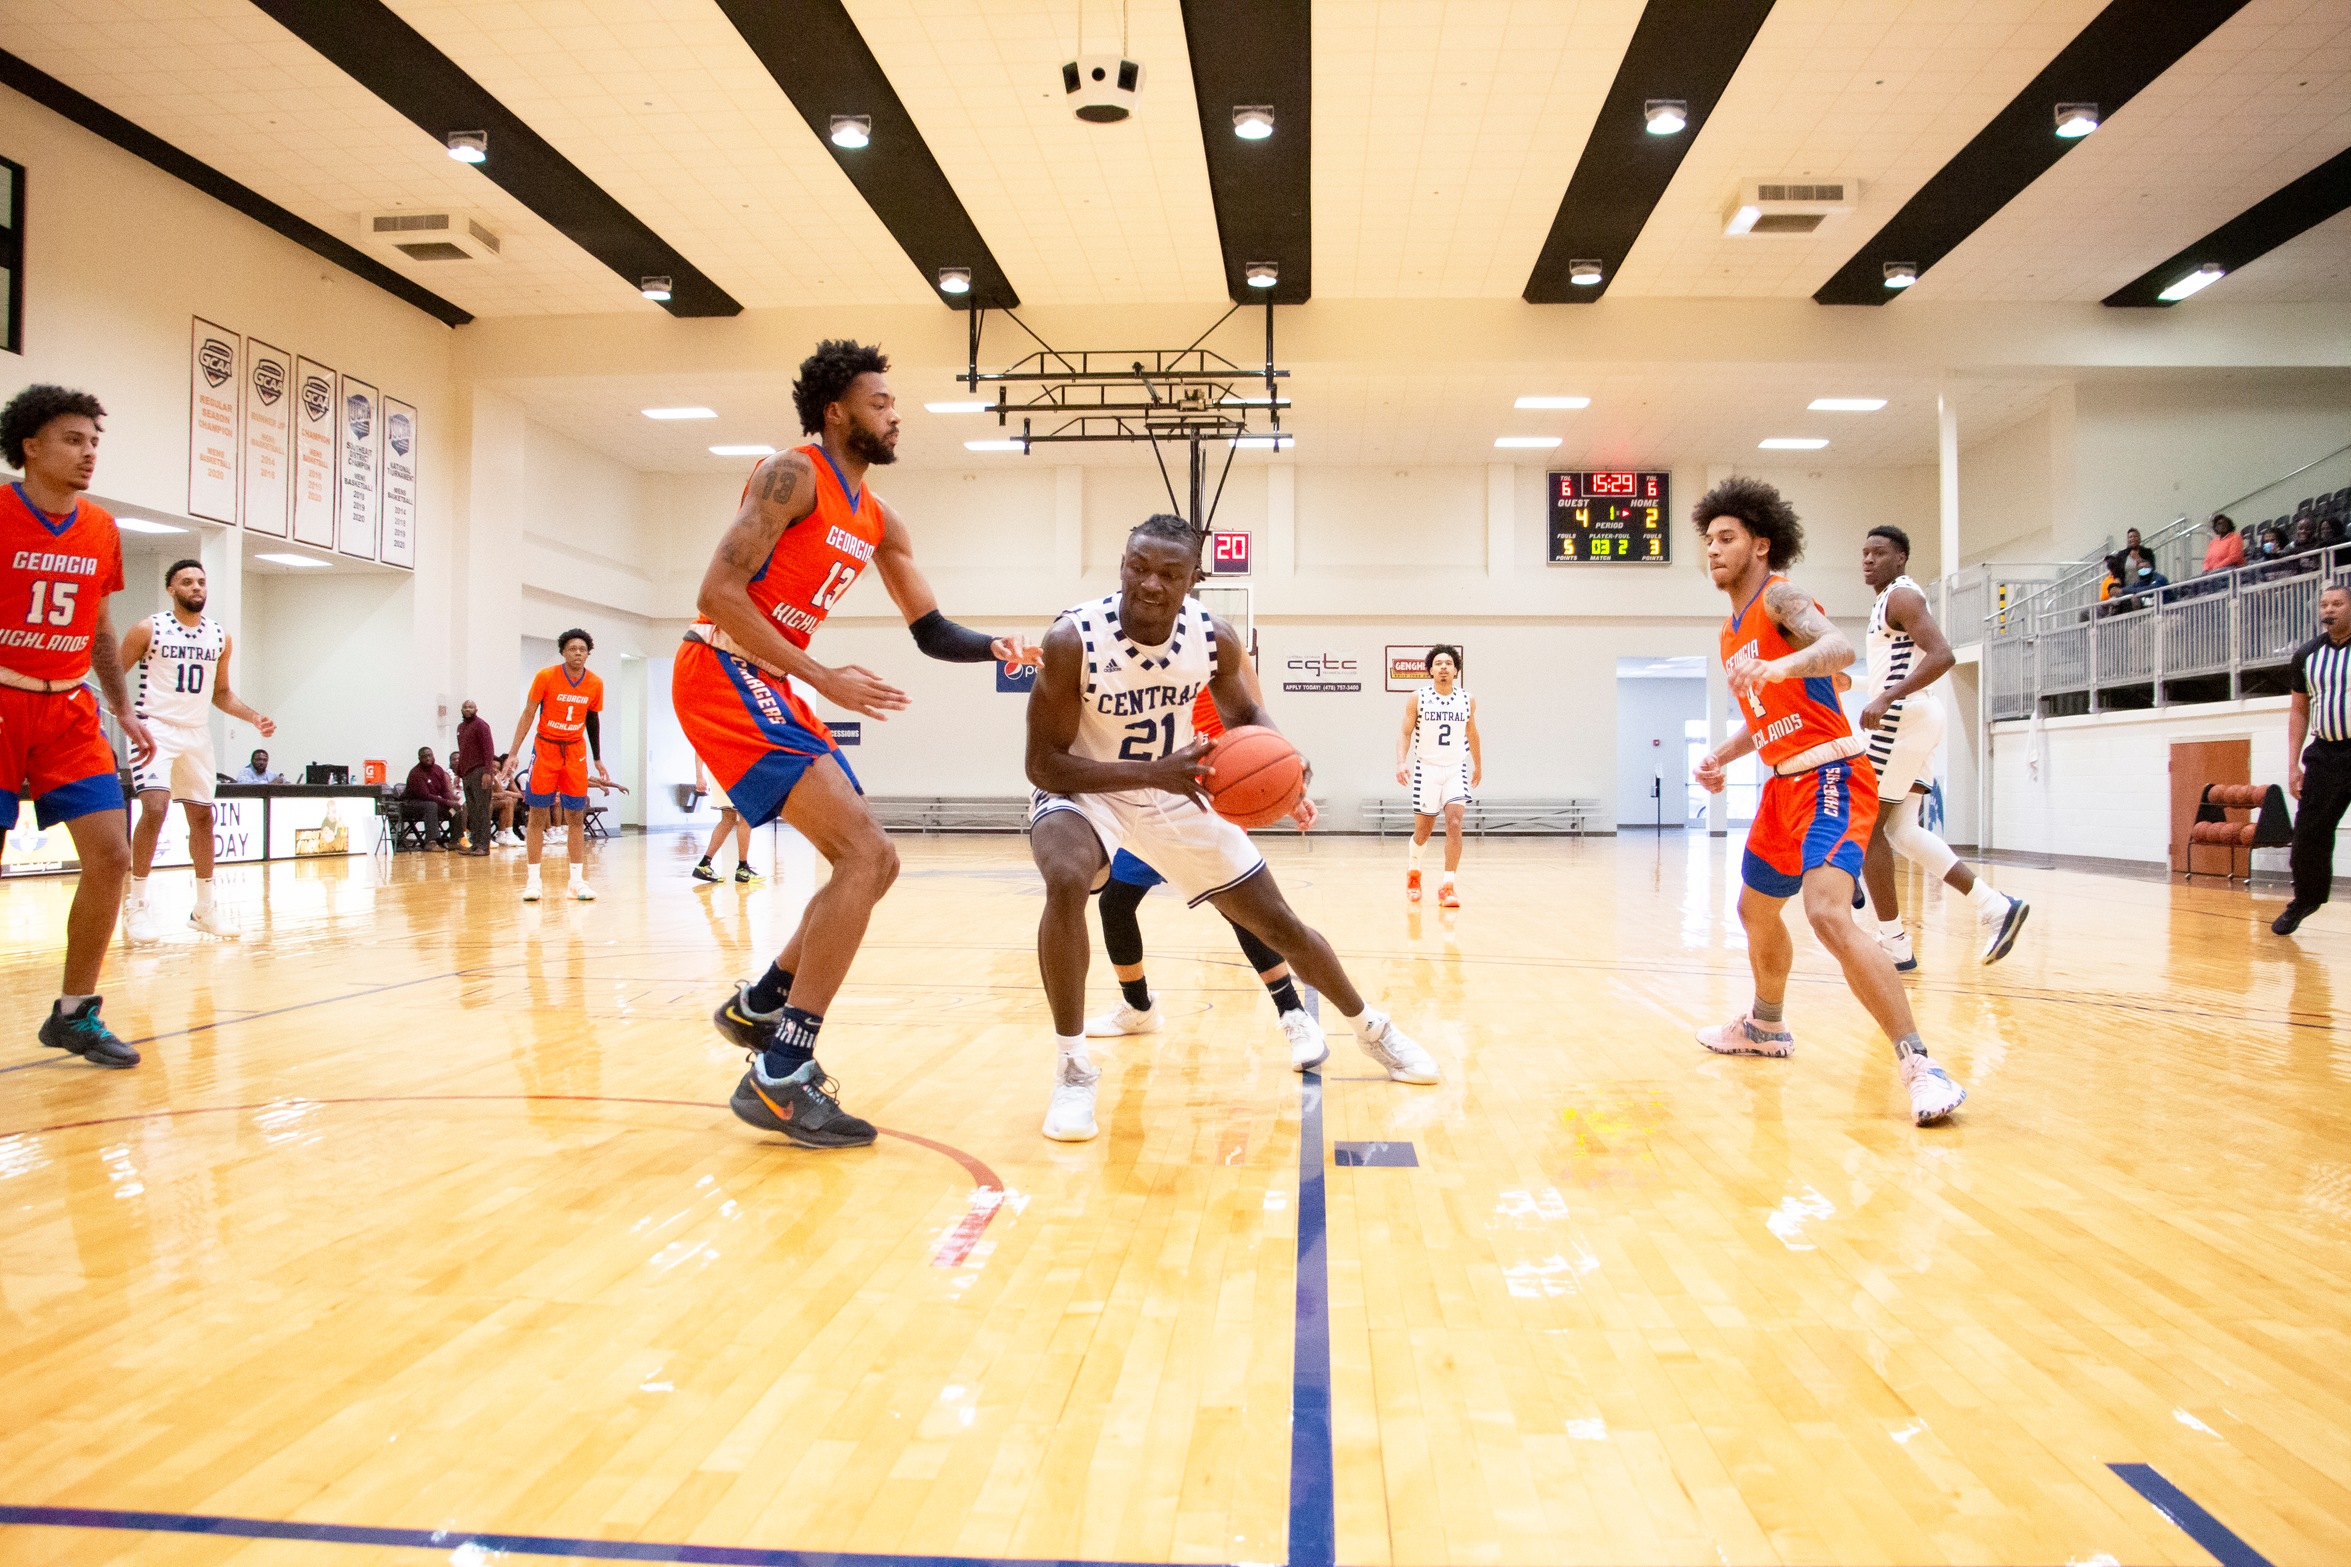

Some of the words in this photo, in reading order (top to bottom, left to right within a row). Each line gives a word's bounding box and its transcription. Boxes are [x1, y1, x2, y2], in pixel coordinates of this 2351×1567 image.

[199, 348, 232, 377] GCAA
[253, 366, 284, 395] GCAA
[199, 394, 233, 413] REGULAR
[201, 407, 230, 424] SEASON
[198, 419, 233, 437] CHAMPION
[301, 428, 331, 445] CHAMPION
[199, 453, 232, 470] BASKETBALL
[390, 461, 411, 475] NATIONAL
[207, 468, 224, 480] 2020
[344, 477, 373, 492] BASKETBALL
[1561, 481, 1571, 496] 6
[1592, 474, 1633, 492] 15:29
[1647, 481, 1657, 496] 6
[1557, 499, 1590, 507] GUEST
[1630, 499, 1659, 507] HOME
[1575, 508, 1588, 528] 4
[1645, 508, 1658, 528] 2
[826, 525, 875, 562] GEORGIA
[1217, 535, 1246, 560] 20
[1563, 539, 1574, 555] 5
[1649, 539, 1660, 555] 3
[12, 551, 98, 576] GEORGIA
[811, 560, 856, 611] 13
[25, 579, 79, 627] 15
[771, 601, 823, 635] HIGHL
[161, 645, 217, 661] CENTRAL
[1287, 653, 1357, 677] cgtc
[1395, 662, 1426, 671] GENGHI
[175, 663, 204, 694] 10
[556, 693, 589, 704] GEORGIA
[1097, 681, 1201, 716] CENTRAL
[565, 705, 574, 721] 1
[1424, 711, 1466, 722] CENTRAL
[1118, 712, 1175, 761] 21
[1438, 724, 1451, 746] 2
[366, 766, 374, 776] G
